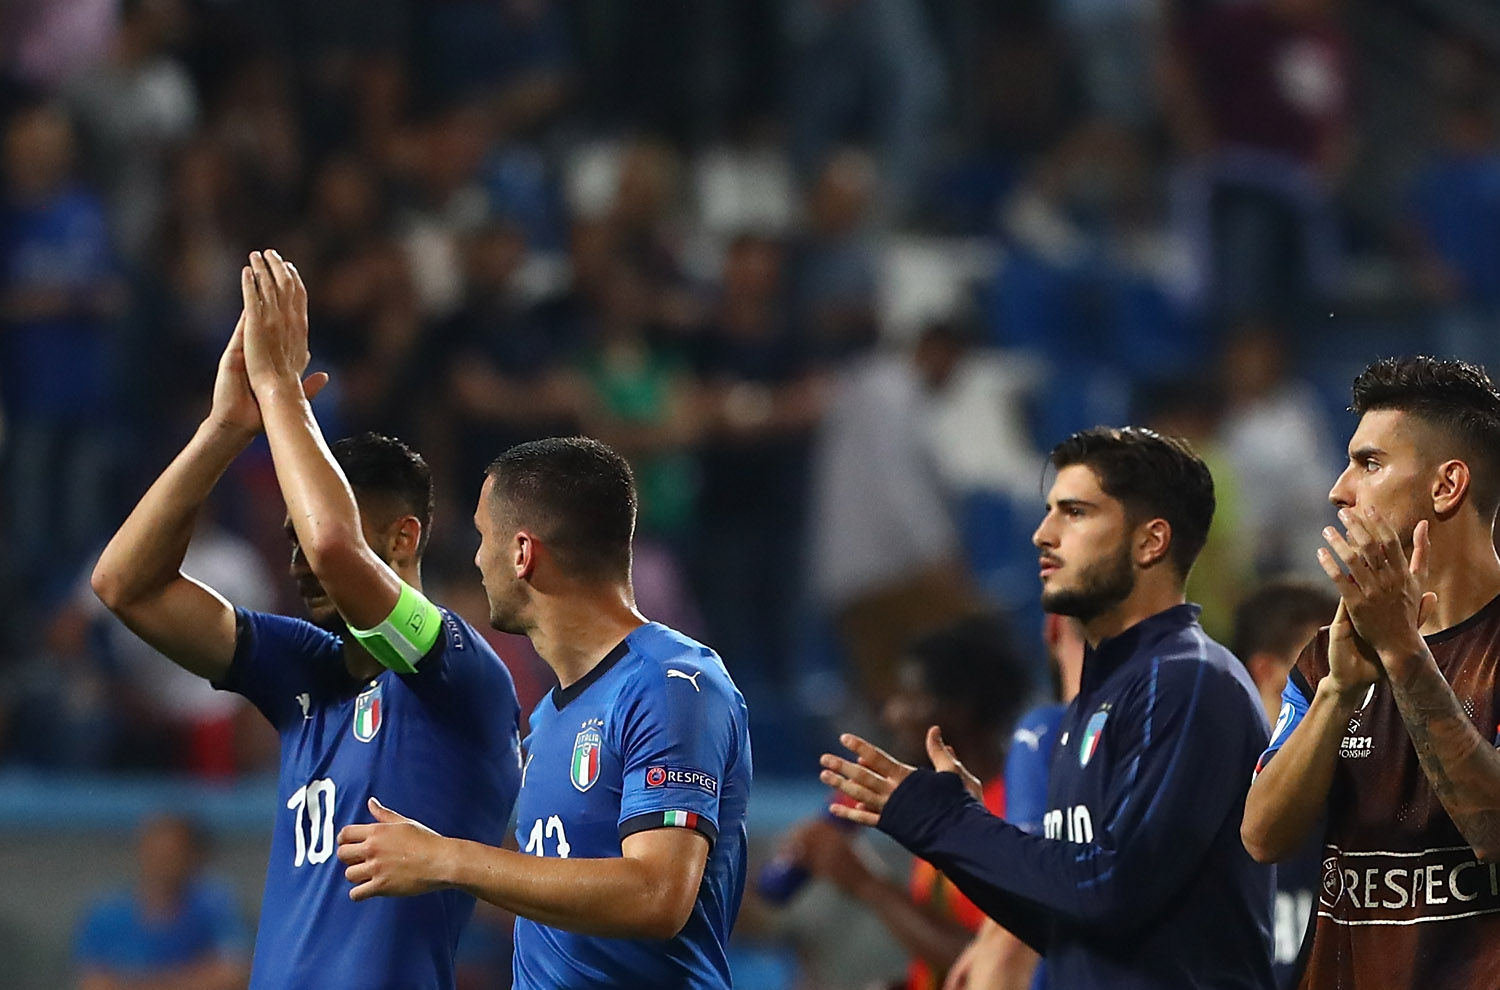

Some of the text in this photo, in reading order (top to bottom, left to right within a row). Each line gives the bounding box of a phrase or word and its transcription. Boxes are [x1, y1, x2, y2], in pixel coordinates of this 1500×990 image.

[577, 733, 600, 745] ITALIA
[1341, 737, 1372, 749] ER21
[668, 771, 717, 791] RESPECT
[287, 777, 336, 867] 10
